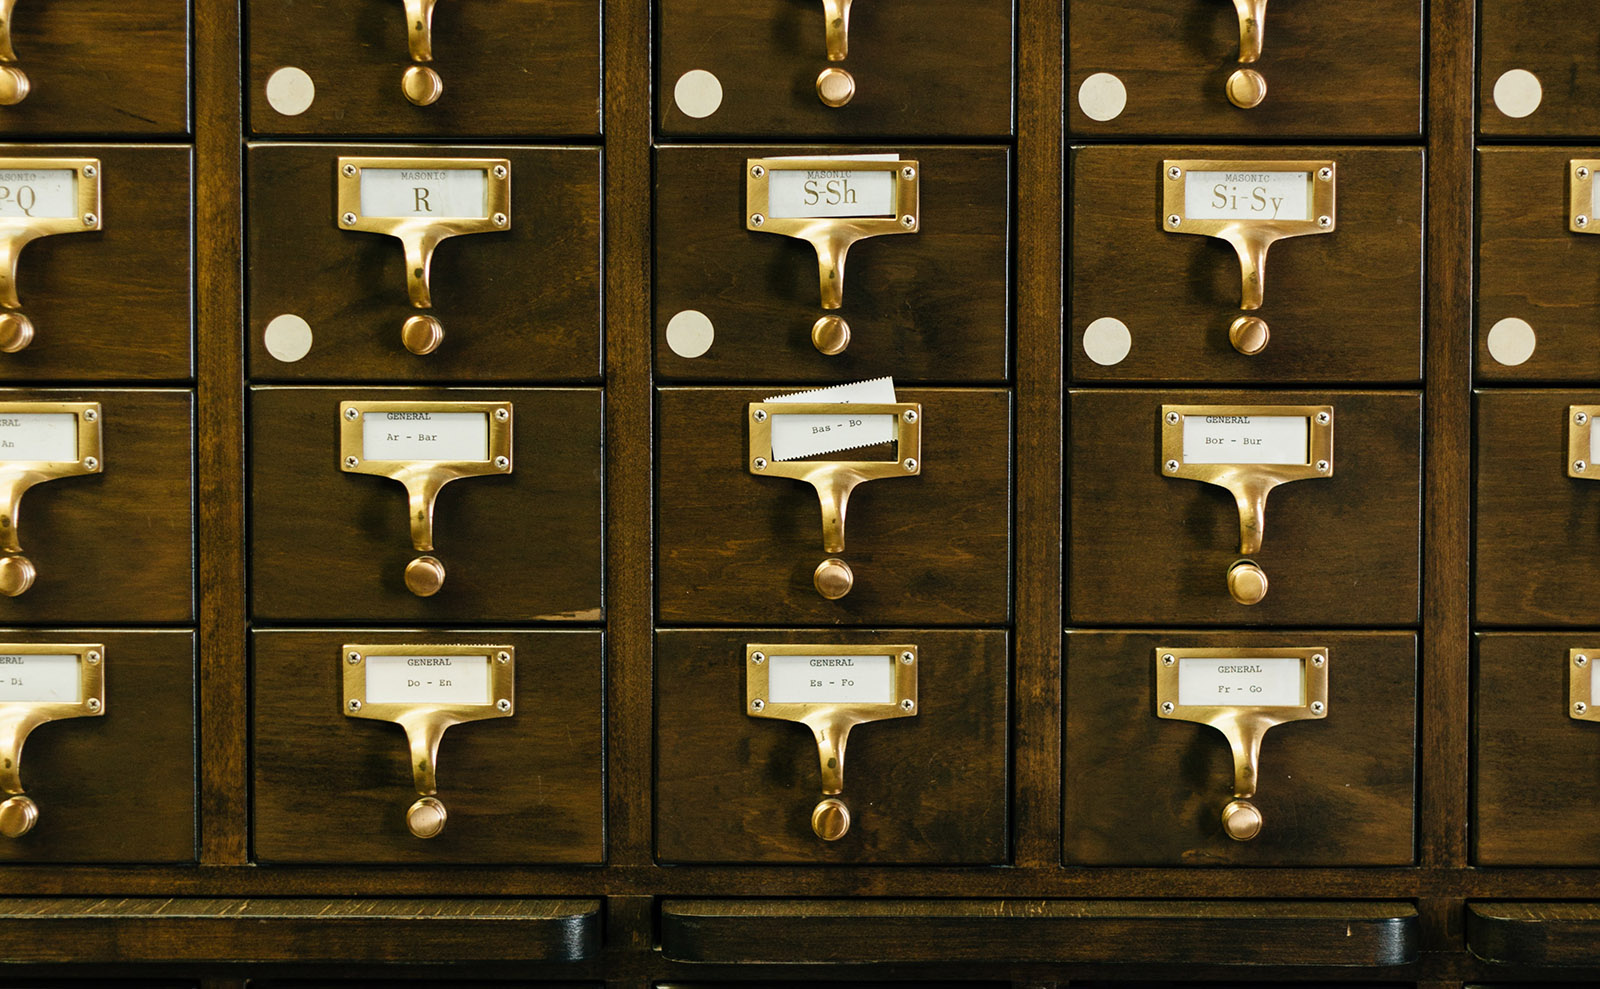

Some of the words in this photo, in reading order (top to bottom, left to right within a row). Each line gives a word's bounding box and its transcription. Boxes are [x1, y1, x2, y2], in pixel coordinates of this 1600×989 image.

[401, 171, 446, 180] MASONIC
[807, 170, 852, 179] MASONIC
[1225, 174, 1270, 182] MASONIC
[804, 179, 857, 206] S-Sh
[413, 187, 432, 213] R
[1211, 184, 1284, 220] Si-Sy
[387, 412, 432, 420] GENERAL
[1206, 415, 1250, 424] GENERAL
[812, 424, 832, 436] Bas
[849, 418, 863, 428] Bo
[386, 433, 400, 442] Ar
[418, 433, 438, 442] Bar
[1205, 436, 1225, 445] Bor
[1243, 437, 1263, 446] Bur
[1, 440, 15, 448] An
[407, 658, 452, 667] GENERAL
[809, 658, 854, 667] GENERAL
[1217, 664, 1263, 674] GENERAL
[11, 677, 24, 686] Di
[407, 679, 421, 688] Do
[439, 679, 452, 688] En
[809, 679, 823, 688] Es
[841, 678, 855, 688] Fo
[1218, 685, 1231, 694] Fr
[1249, 684, 1263, 693] Go
